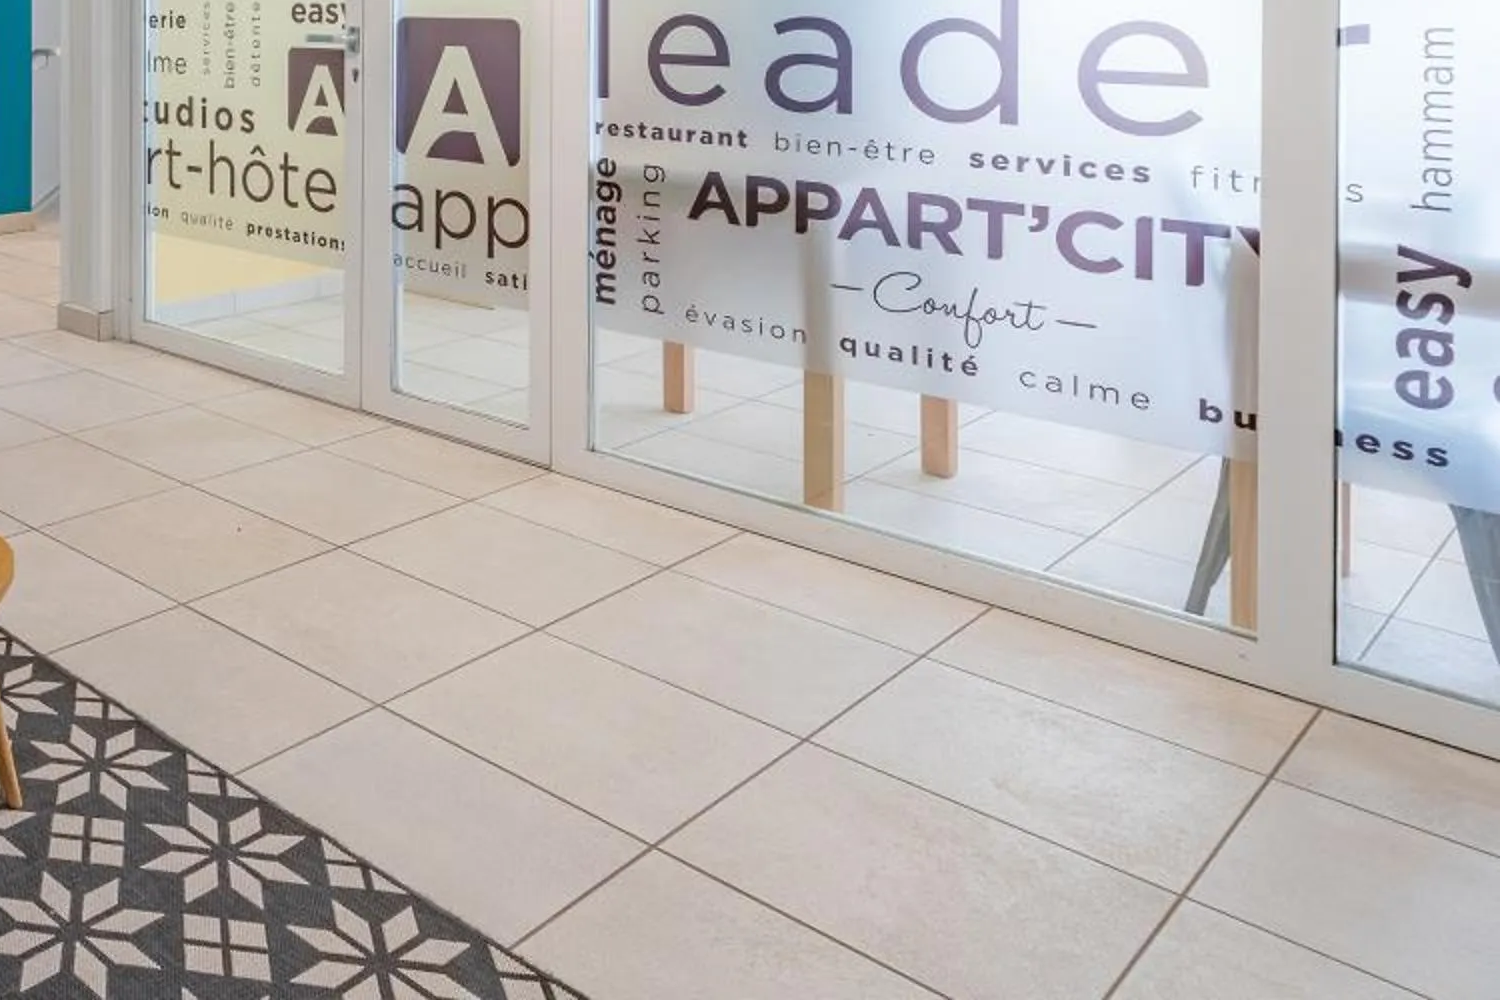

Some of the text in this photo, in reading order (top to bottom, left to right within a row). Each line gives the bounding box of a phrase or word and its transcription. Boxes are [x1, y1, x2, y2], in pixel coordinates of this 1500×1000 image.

[223, 0, 236, 89] bien-être
[595, 121, 749, 149] restaurant
[774, 132, 936, 166] bien-être
[969, 149, 1152, 184] services
[1410, 26, 1456, 213] hammam
[392, 183, 530, 259] app
[393, 254, 468, 279] accueil
[588, 157, 623, 306] ménage
[637, 164, 666, 315] parking
[684, 304, 808, 344] évasion
[839, 336, 980, 377] qualité
[1018, 370, 1151, 410] calme
[1395, 244, 1473, 411] easy
